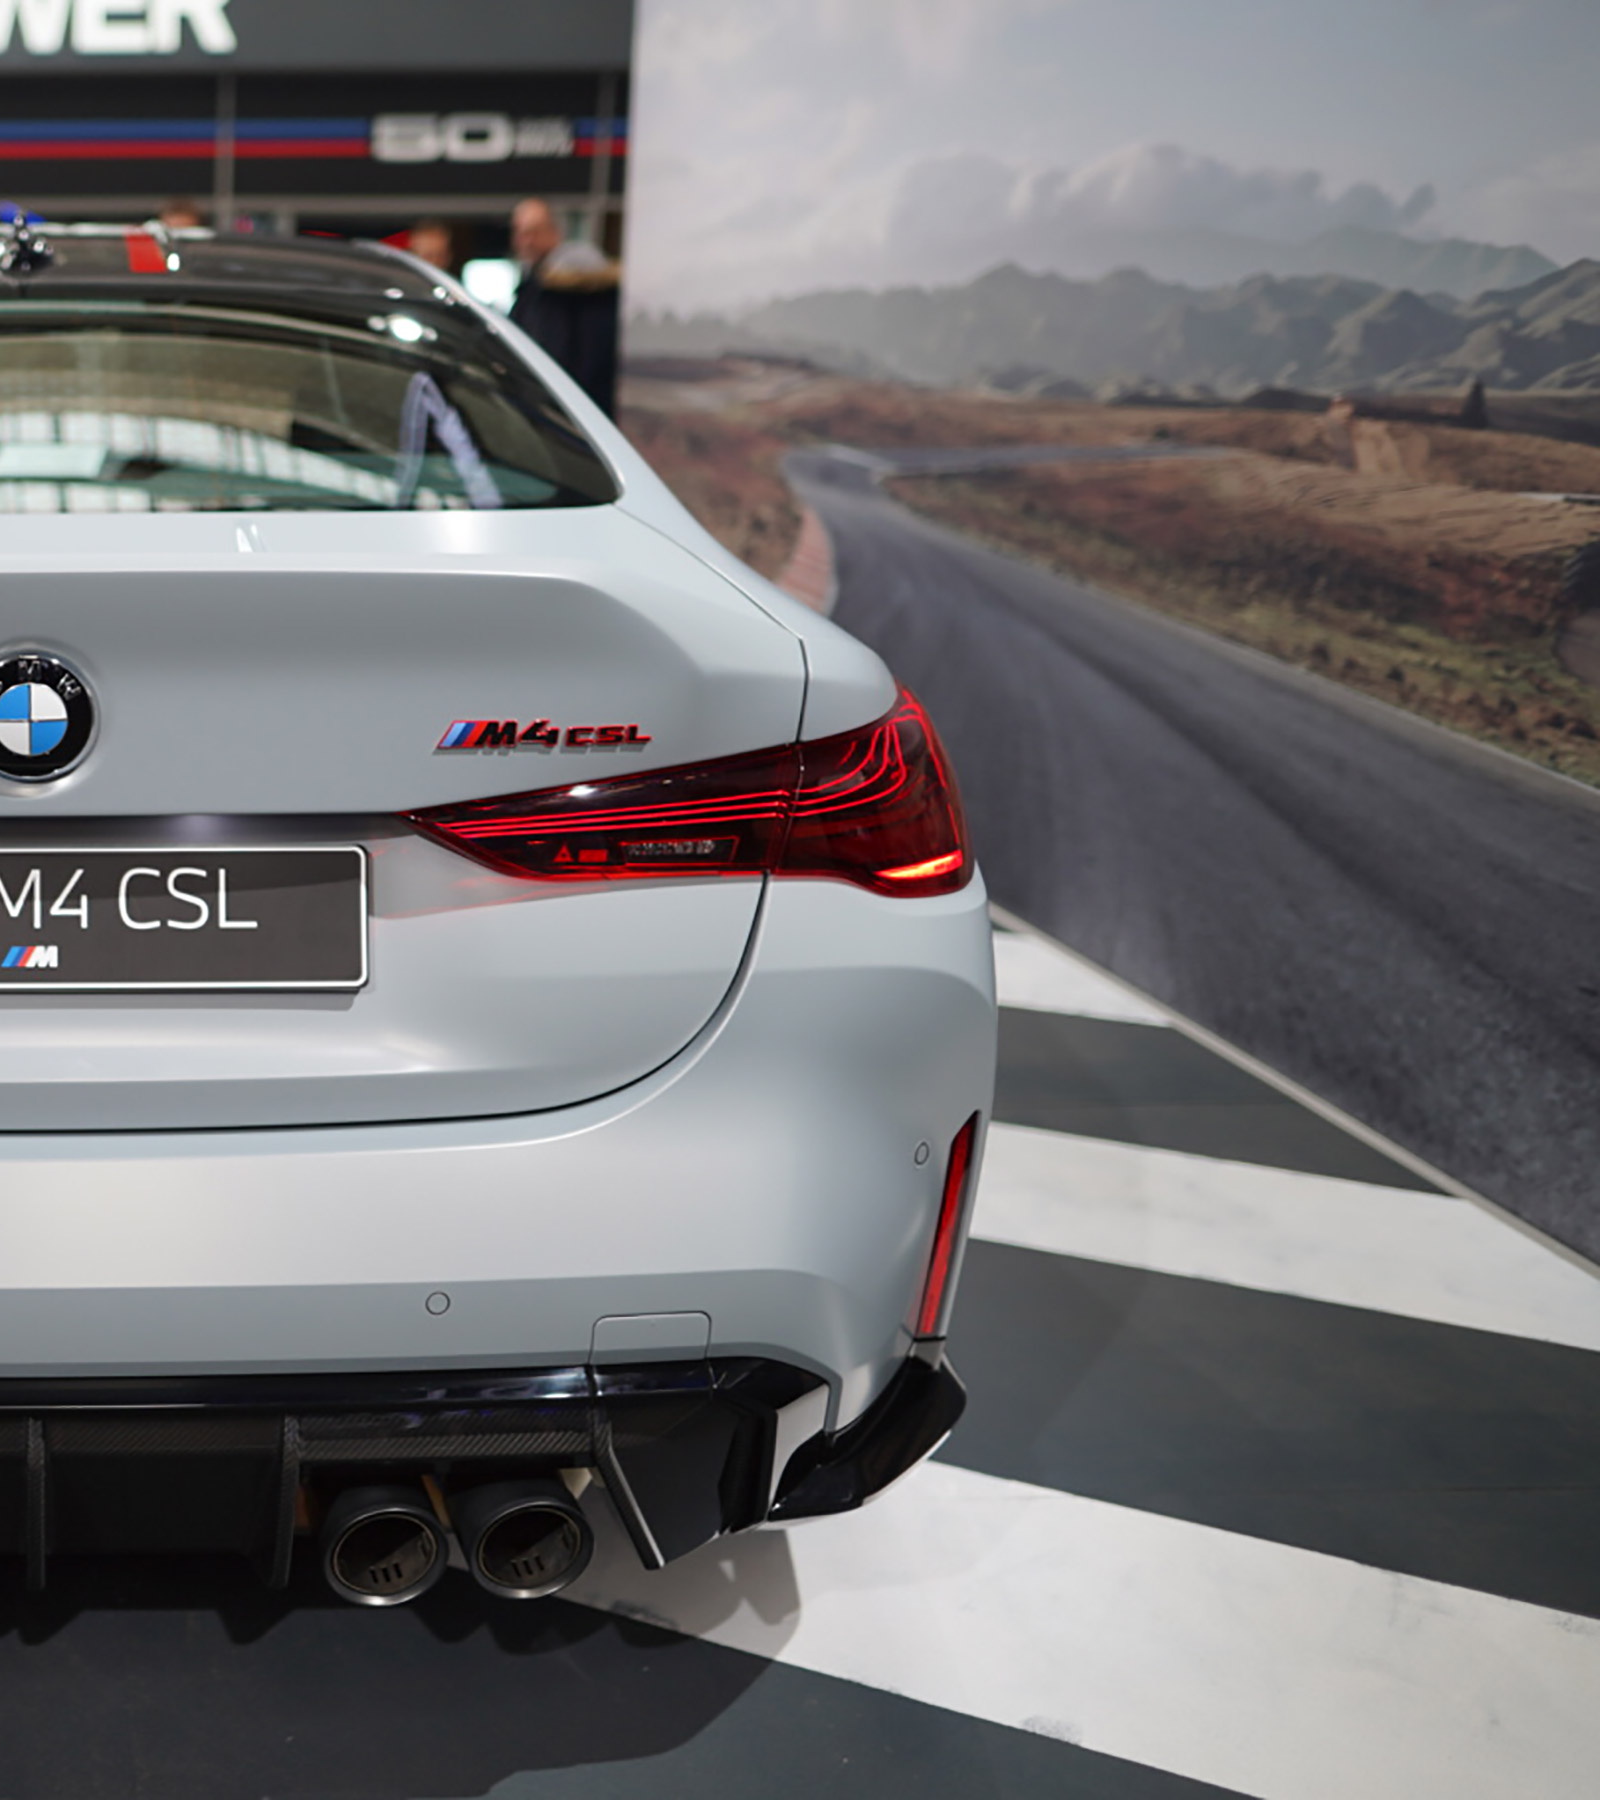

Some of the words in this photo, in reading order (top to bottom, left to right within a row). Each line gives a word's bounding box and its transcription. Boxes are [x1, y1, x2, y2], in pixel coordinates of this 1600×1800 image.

[370, 113, 515, 162] 50
[563, 724, 652, 746] CSL
[118, 866, 258, 931] CSL
